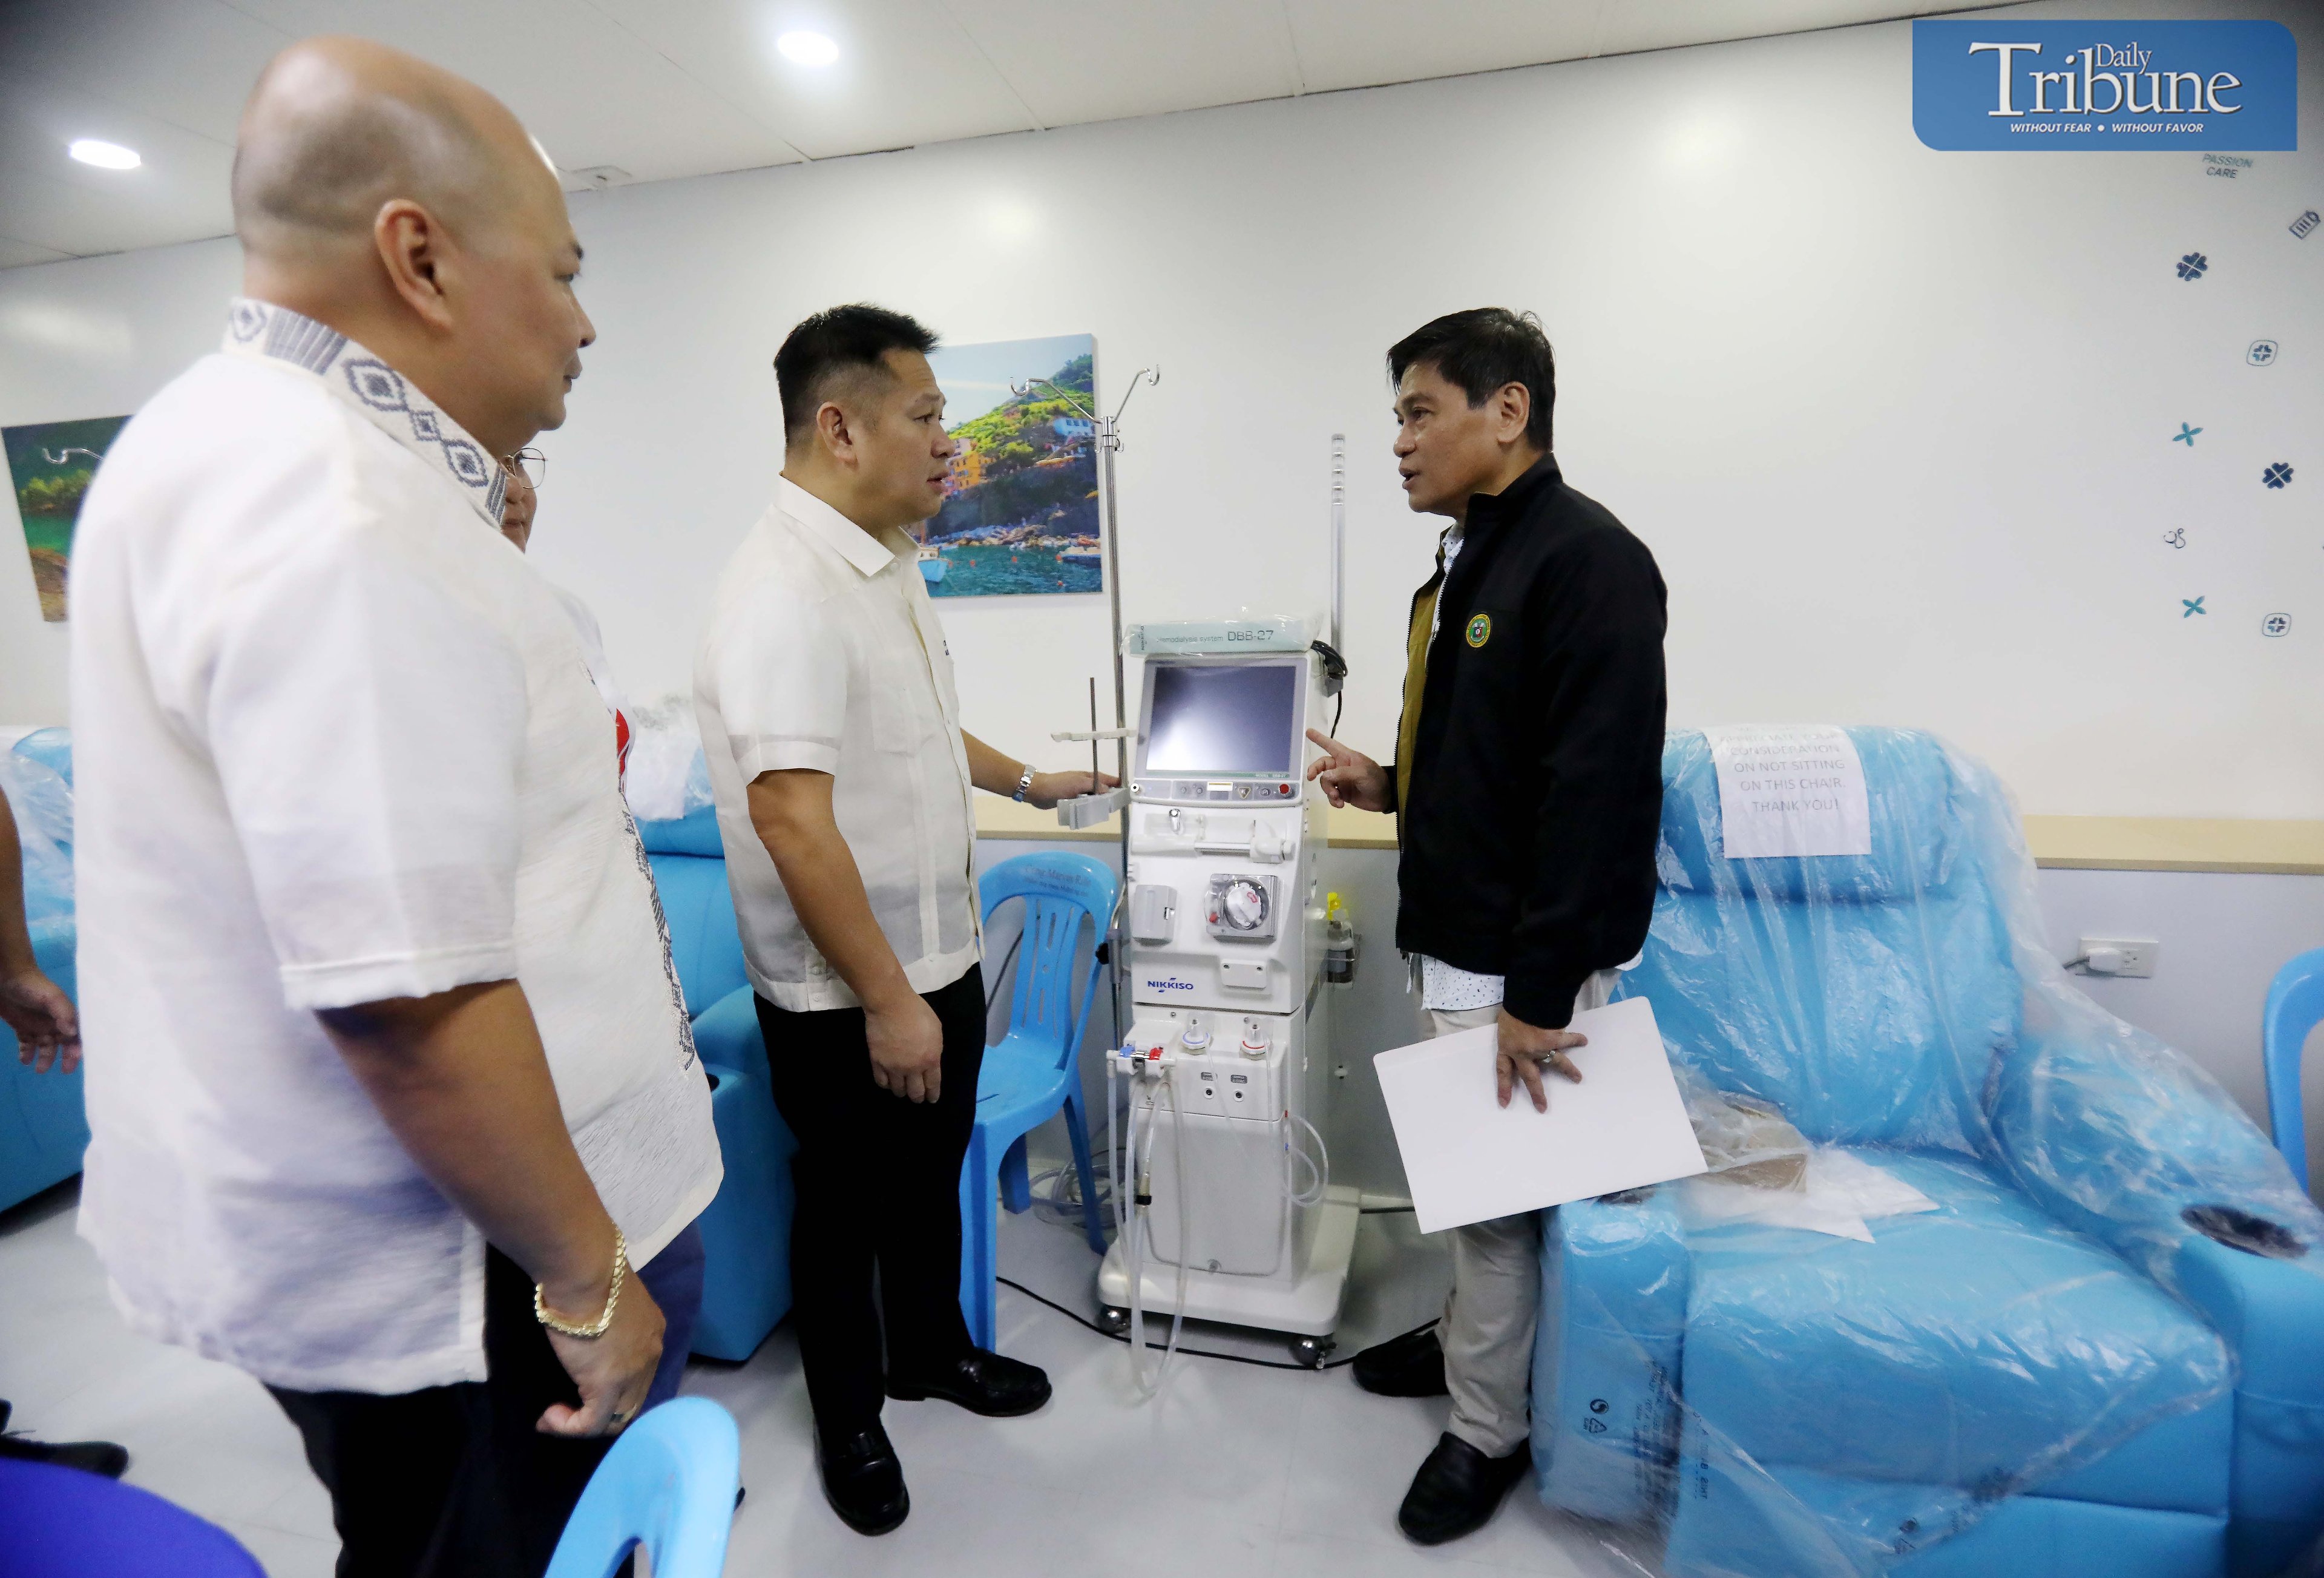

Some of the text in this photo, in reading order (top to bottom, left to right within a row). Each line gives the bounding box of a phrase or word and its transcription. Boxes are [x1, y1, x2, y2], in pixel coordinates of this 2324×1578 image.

[2202, 153, 2253, 169] PASSION
[2206, 166, 2238, 179] CARE
[1227, 630, 1274, 642] DBB-27
[1734, 759, 1845, 773] ON NOT SITTING
[1740, 780, 1762, 792] ON
[1765, 779, 1796, 790] THIS
[1752, 798, 1840, 812] THANK YOU!
[1147, 979, 1194, 991] NIKKISO
